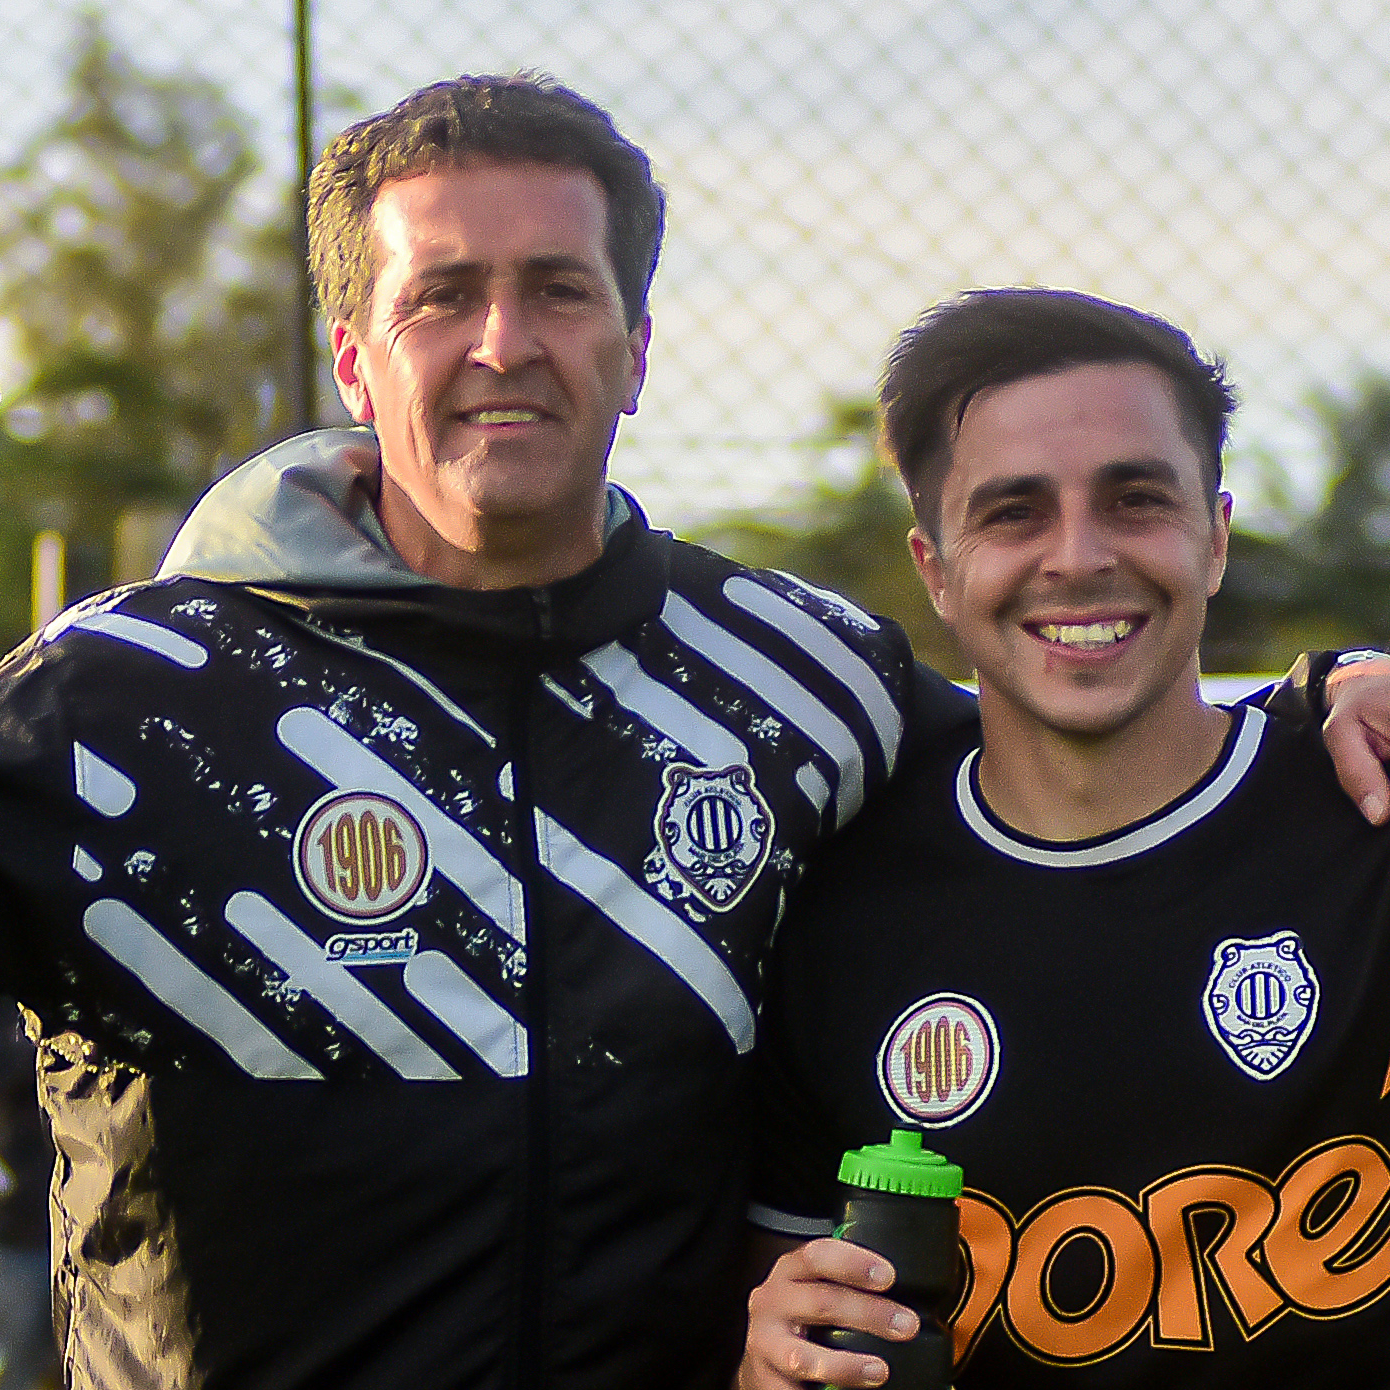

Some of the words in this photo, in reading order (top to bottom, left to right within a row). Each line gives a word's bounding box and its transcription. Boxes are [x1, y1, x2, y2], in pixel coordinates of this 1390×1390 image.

[316, 810, 407, 901] 1906
[325, 931, 415, 962] gsport
[899, 1015, 974, 1103] 1906
